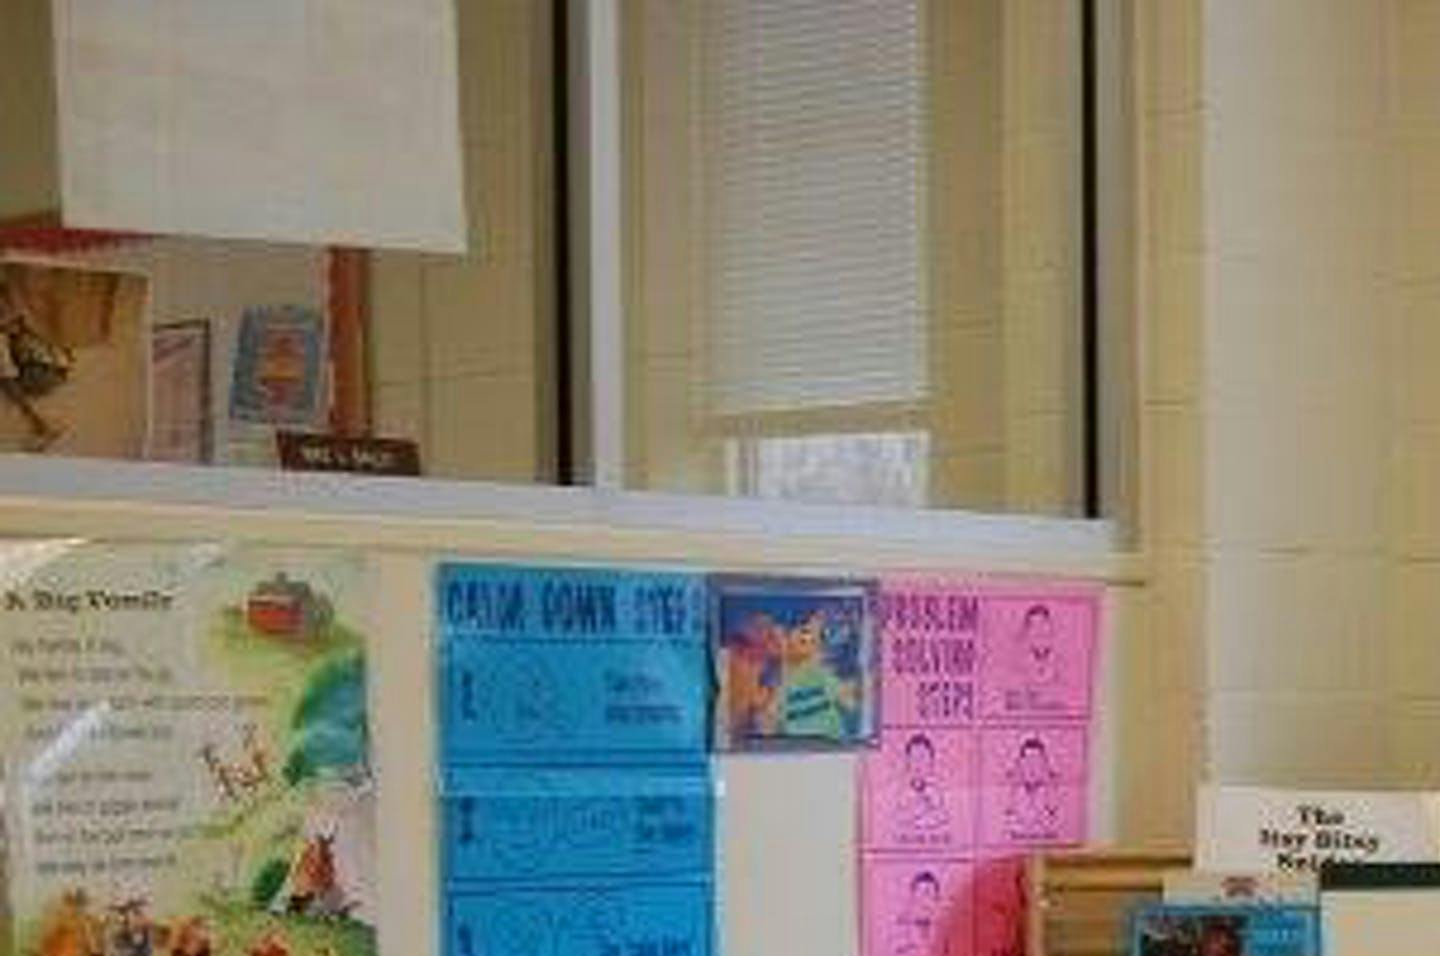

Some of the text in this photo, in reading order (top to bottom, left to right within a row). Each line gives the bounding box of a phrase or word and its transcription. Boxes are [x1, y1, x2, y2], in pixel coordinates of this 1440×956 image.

[447, 579, 526, 630] CALM
[541, 580, 618, 633] DOWN
[1297, 805, 1345, 825] The
